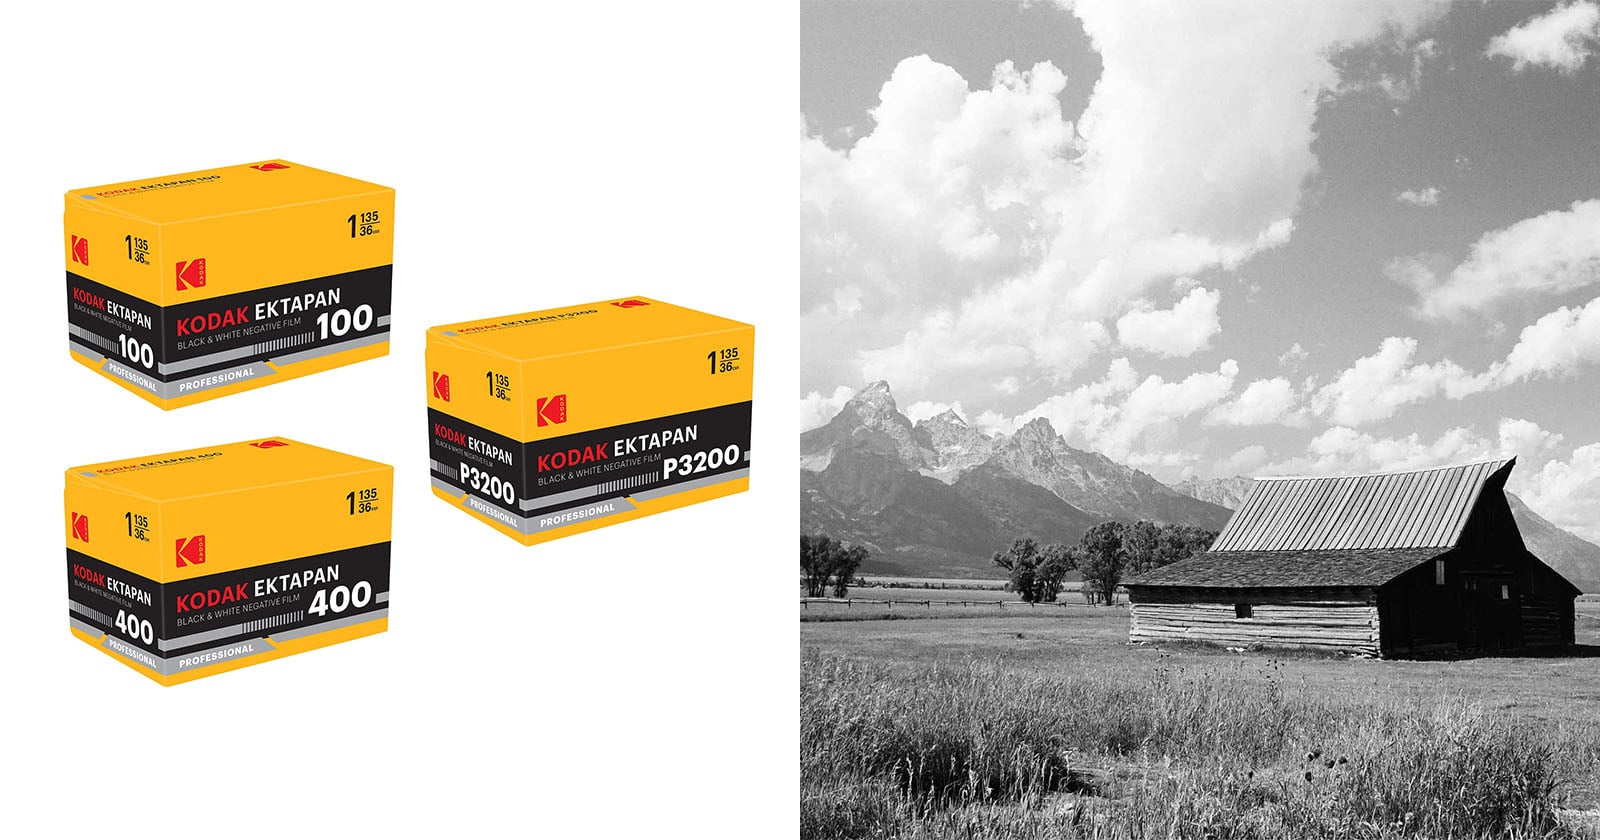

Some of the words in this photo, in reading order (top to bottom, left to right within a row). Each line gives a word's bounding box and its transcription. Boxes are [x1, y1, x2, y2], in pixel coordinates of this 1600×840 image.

[347, 214, 357, 238] 1
[360, 211, 379, 223] 135
[134, 237, 149, 251] 135
[359, 225, 373, 237] 36
[125, 234, 132, 260] 1
[134, 251, 145, 264] 36
[73, 287, 105, 311] KODAK
[107, 300, 152, 330] EKTAPAN
[177, 306, 249, 337] KODAK
[255, 288, 341, 321] EKTAPAN
[177, 338, 205, 351] BLACK
[207, 336, 213, 344] &
[214, 330, 241, 343] WHITE
[243, 321, 282, 336] NEGATIVE
[283, 317, 301, 328] FILM
[316, 304, 374, 340] 100
[118, 333, 154, 369] 100
[707, 350, 717, 375] 1
[720, 347, 739, 359] 135
[109, 363, 157, 392] PROFESSIONAL
[179, 368, 255, 392] PROFESSIONAL
[495, 373, 509, 387] 135
[719, 361, 733, 373] 36
[486, 370, 493, 396] 1
[495, 387, 506, 400] 36
[434, 423, 467, 447] KODAK
[468, 436, 513, 466] EKTAPAN
[537, 442, 609, 473] KODAK
[614, 424, 698, 457] EKTAPAN
[538, 474, 566, 486] BLACK
[575, 465, 601, 478] WHITE
[603, 456, 642, 472] NEGATIVE
[643, 453, 661, 464] FILM
[663, 444, 739, 480] P3200
[359, 488, 377, 500] 135
[460, 461, 515, 505] P3200
[346, 491, 355, 516] 1
[358, 502, 372, 514] 36
[470, 498, 518, 527] PROFESSIONAL
[540, 503, 615, 528] PROFESSIONAL
[125, 511, 132, 537] 1
[134, 514, 148, 528] 135
[134, 528, 145, 541] 36
[73, 563, 105, 588] KODAK
[107, 577, 152, 607] EKTAPAN
[176, 582, 249, 613] KODAK
[254, 564, 339, 597] EKTAPAN
[177, 615, 205, 627] BLACK
[214, 606, 241, 619] WHITE
[242, 598, 281, 612] NEGATIVE
[282, 593, 300, 604] FILM
[307, 580, 372, 617] 400
[115, 609, 154, 645] 400
[109, 639, 157, 668] PROFESSIONAL
[179, 644, 254, 669] PROFESSIONAL
